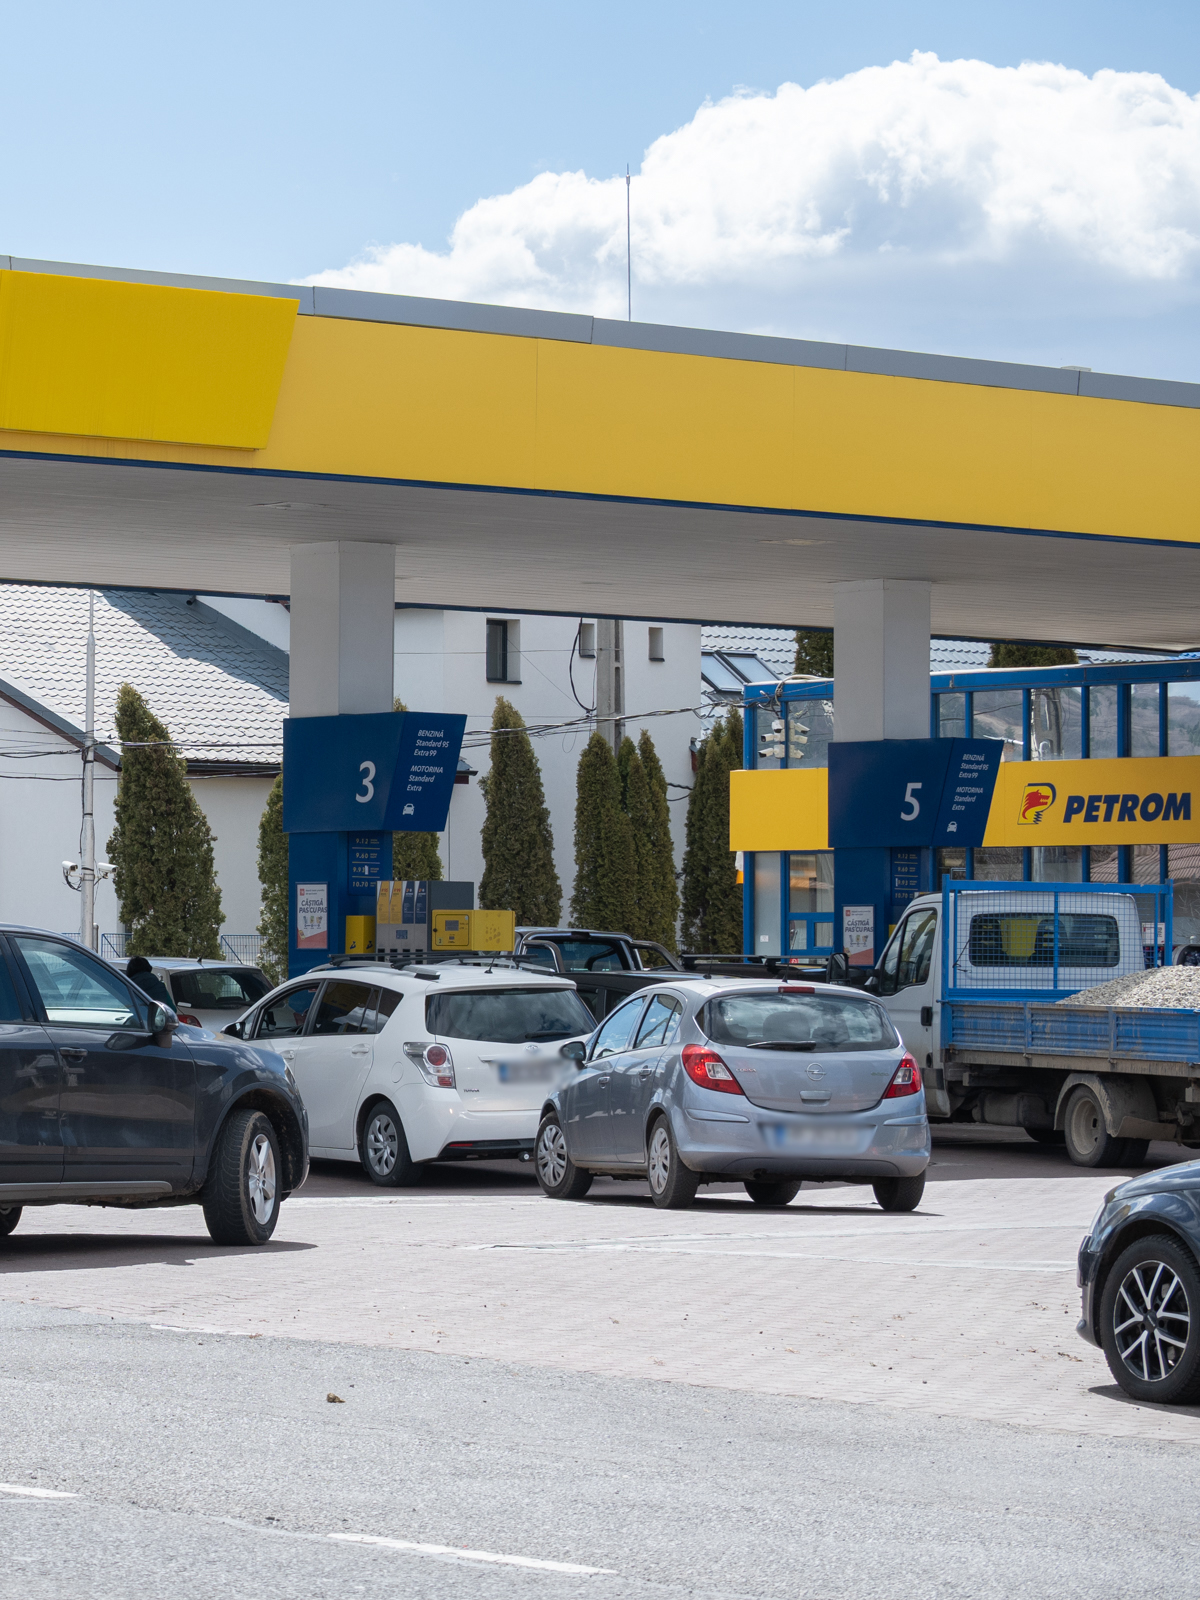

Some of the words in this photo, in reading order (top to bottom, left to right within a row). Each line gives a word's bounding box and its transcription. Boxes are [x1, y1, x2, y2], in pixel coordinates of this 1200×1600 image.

[415, 739, 442, 748] Standard
[413, 749, 429, 757] Extra
[960, 762, 983, 770] Standard
[355, 760, 376, 803] 3
[408, 774, 435, 783] Standard
[406, 784, 422, 792] Extra
[900, 782, 922, 821] 5
[953, 795, 977, 803] Standard
[1062, 792, 1191, 823] PETROM
